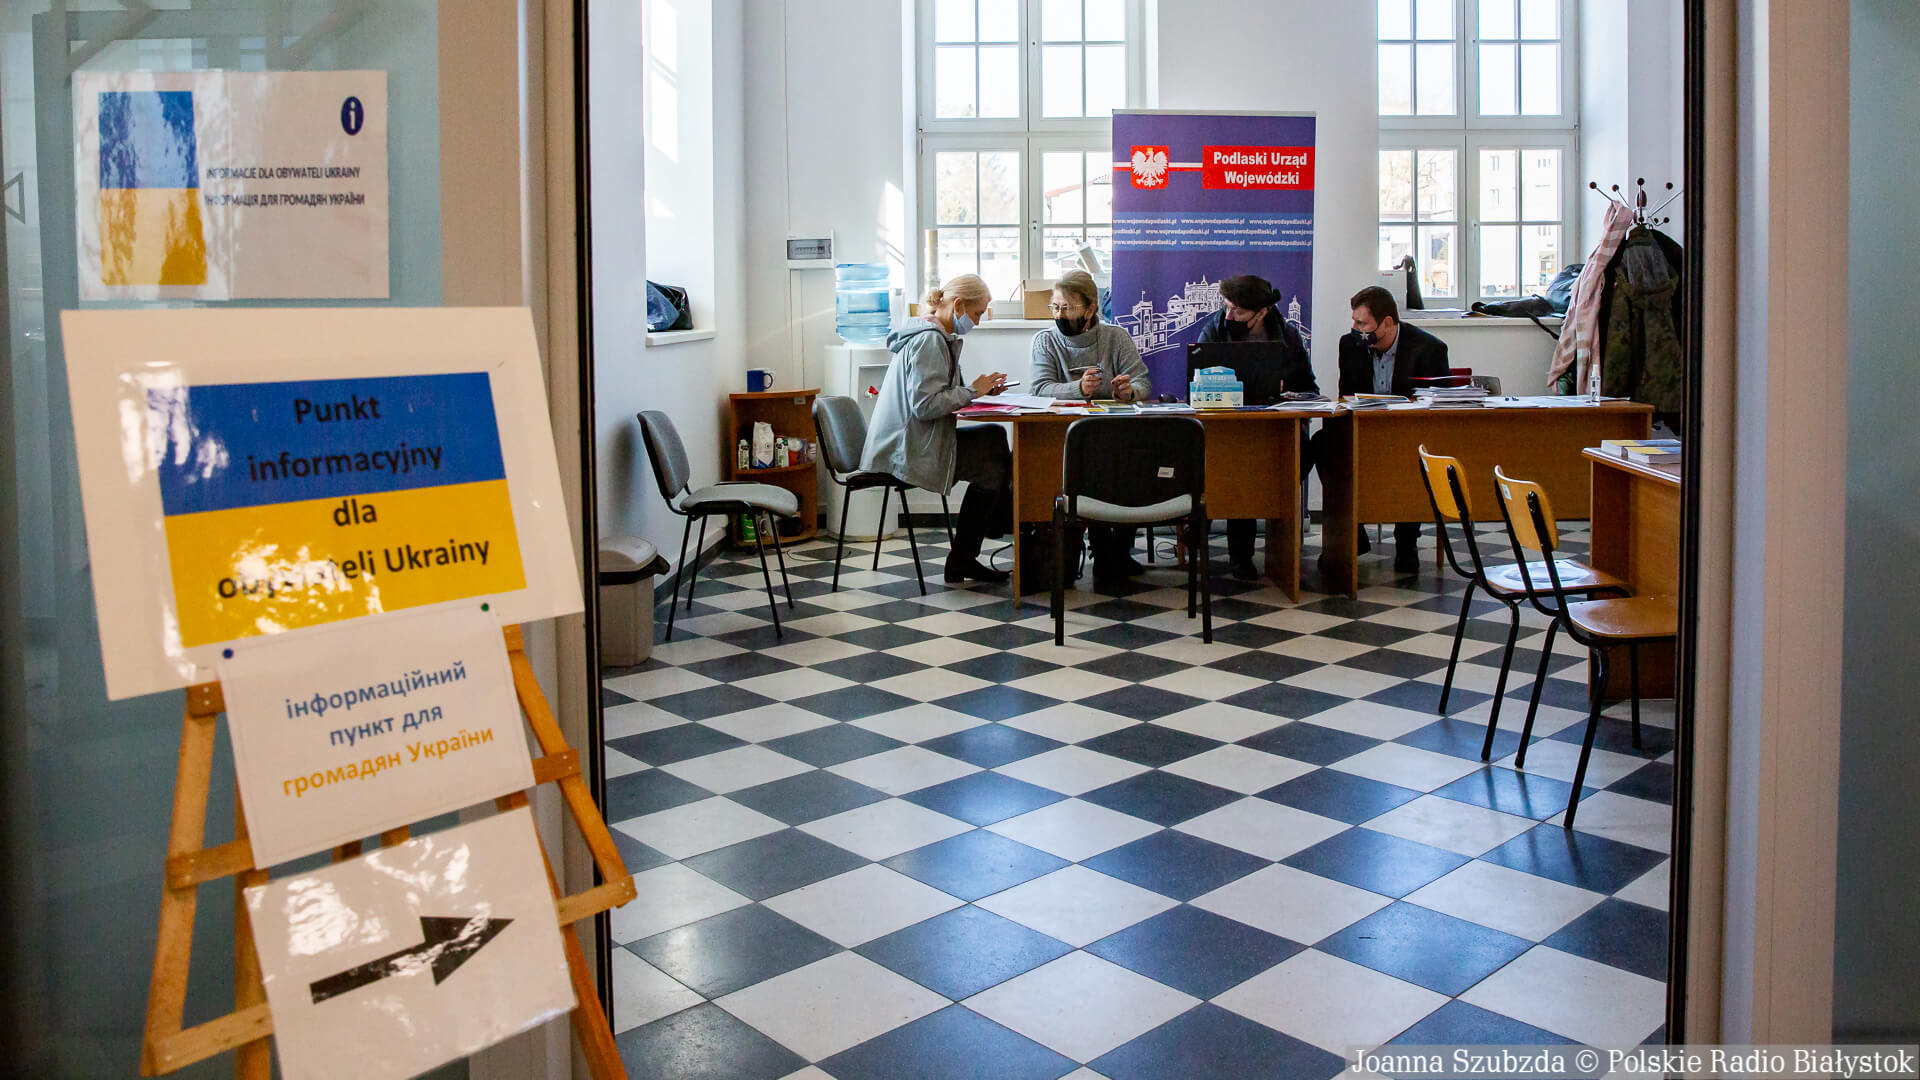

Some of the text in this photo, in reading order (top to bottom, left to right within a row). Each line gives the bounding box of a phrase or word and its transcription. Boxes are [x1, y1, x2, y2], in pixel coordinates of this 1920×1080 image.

[206, 167, 360, 179] INFORMACJE DLA OBYWATELI UKRAINY
[1213, 151, 1307, 169] Podlaski Urząd
[1224, 171, 1300, 188] Wojewódzki
[260, 194, 278, 207] ДЛЯ
[280, 193, 327, 206] ГРОМАДЯН
[329, 192, 365, 205] УКРАЇНИ
[294, 394, 381, 425] Punkt
[248, 443, 443, 482] informacyjny
[333, 498, 378, 527] dla
[217, 538, 489, 599] obteli Ukrainy
[285, 660, 467, 720] інформаційний
[329, 705, 443, 747] пункт для
[282, 727, 494, 798] громадян України
